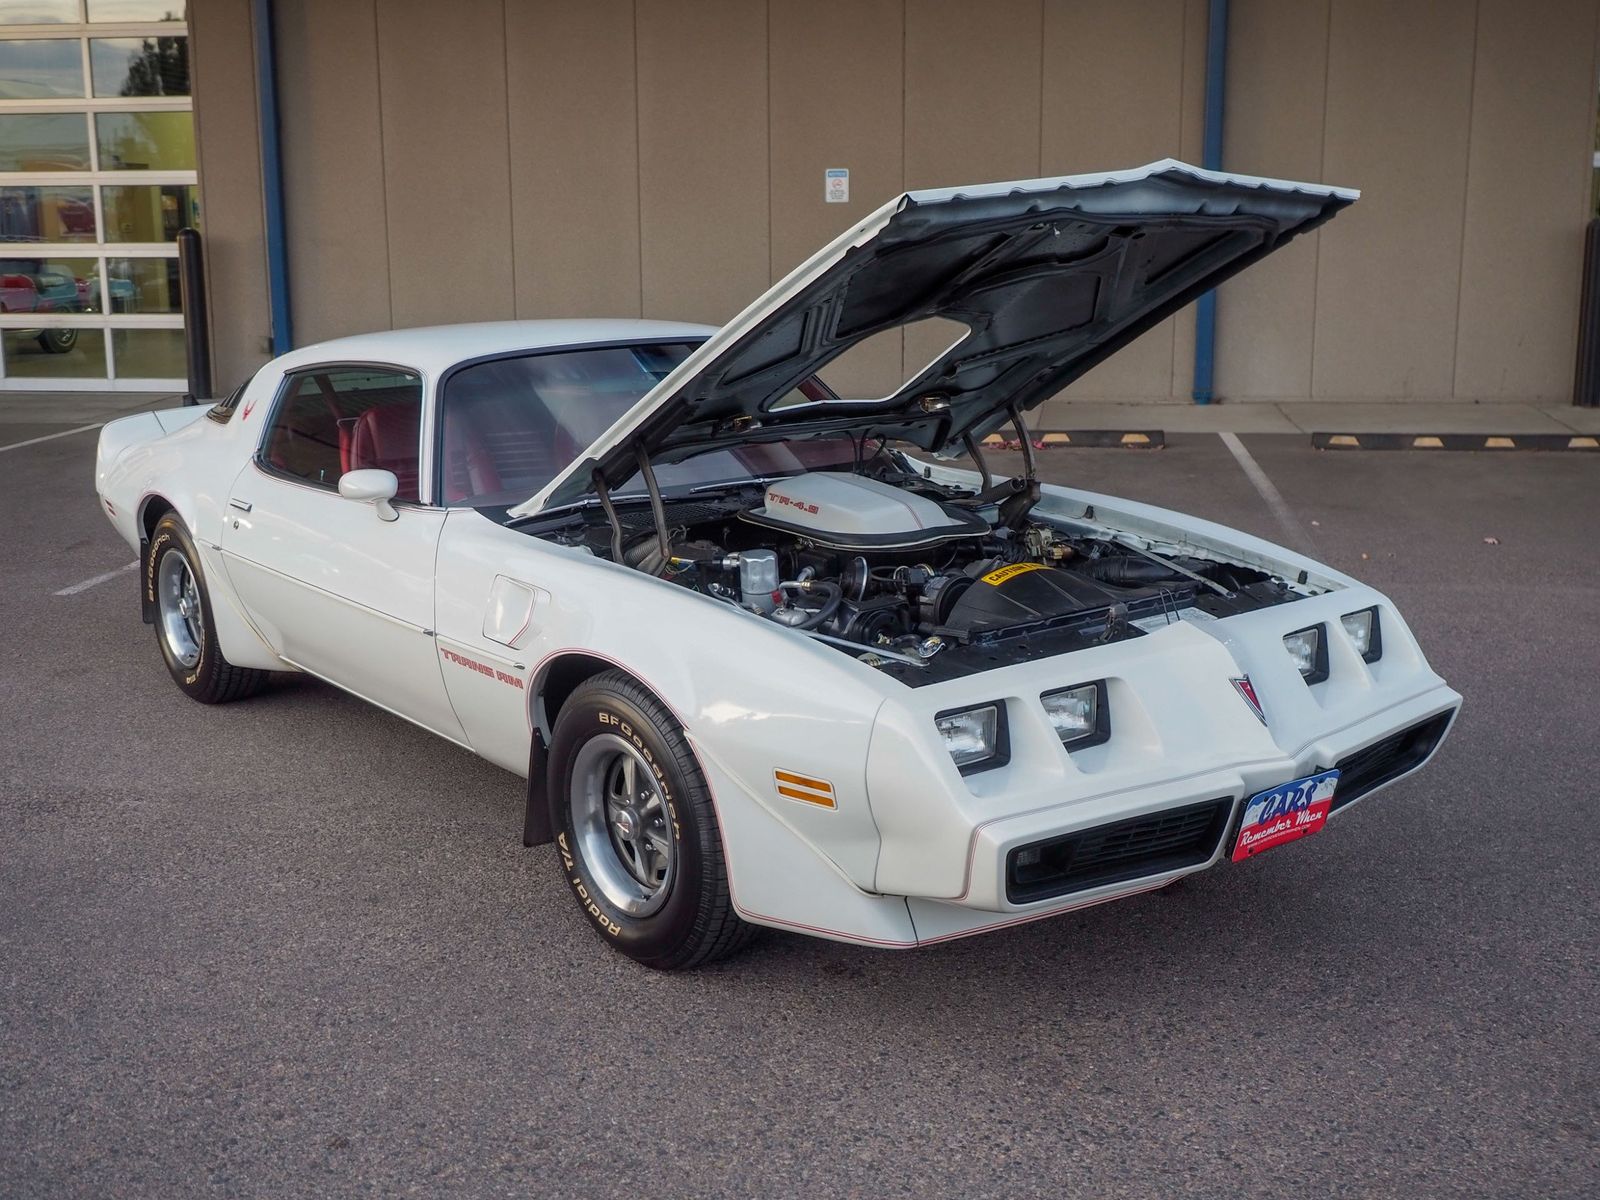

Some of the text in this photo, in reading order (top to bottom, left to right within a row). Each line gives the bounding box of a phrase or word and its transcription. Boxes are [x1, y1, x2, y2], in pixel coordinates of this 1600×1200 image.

[440, 648, 523, 689] TRANS AM
[598, 712, 681, 840] BFGoodrich
[1258, 782, 1318, 825] CARS
[1240, 819, 1291, 847] Remember
[1295, 809, 1322, 826] When
[558, 832, 621, 937] Radial T/A
